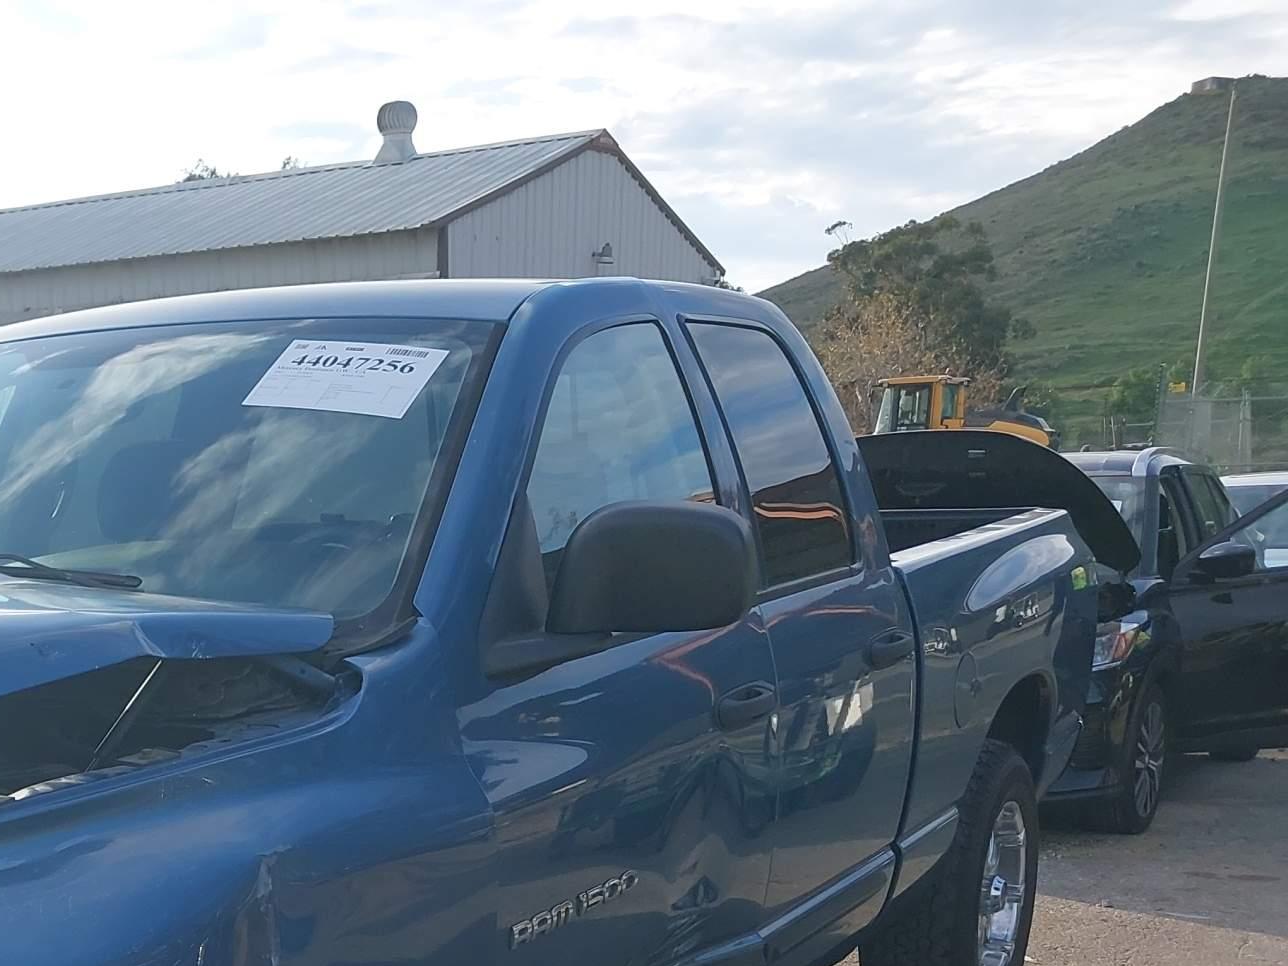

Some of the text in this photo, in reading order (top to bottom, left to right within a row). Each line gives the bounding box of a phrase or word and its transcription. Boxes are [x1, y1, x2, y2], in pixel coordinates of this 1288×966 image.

[291, 353, 416, 375] 44047256
[509, 869, 640, 950] RAM 1500
